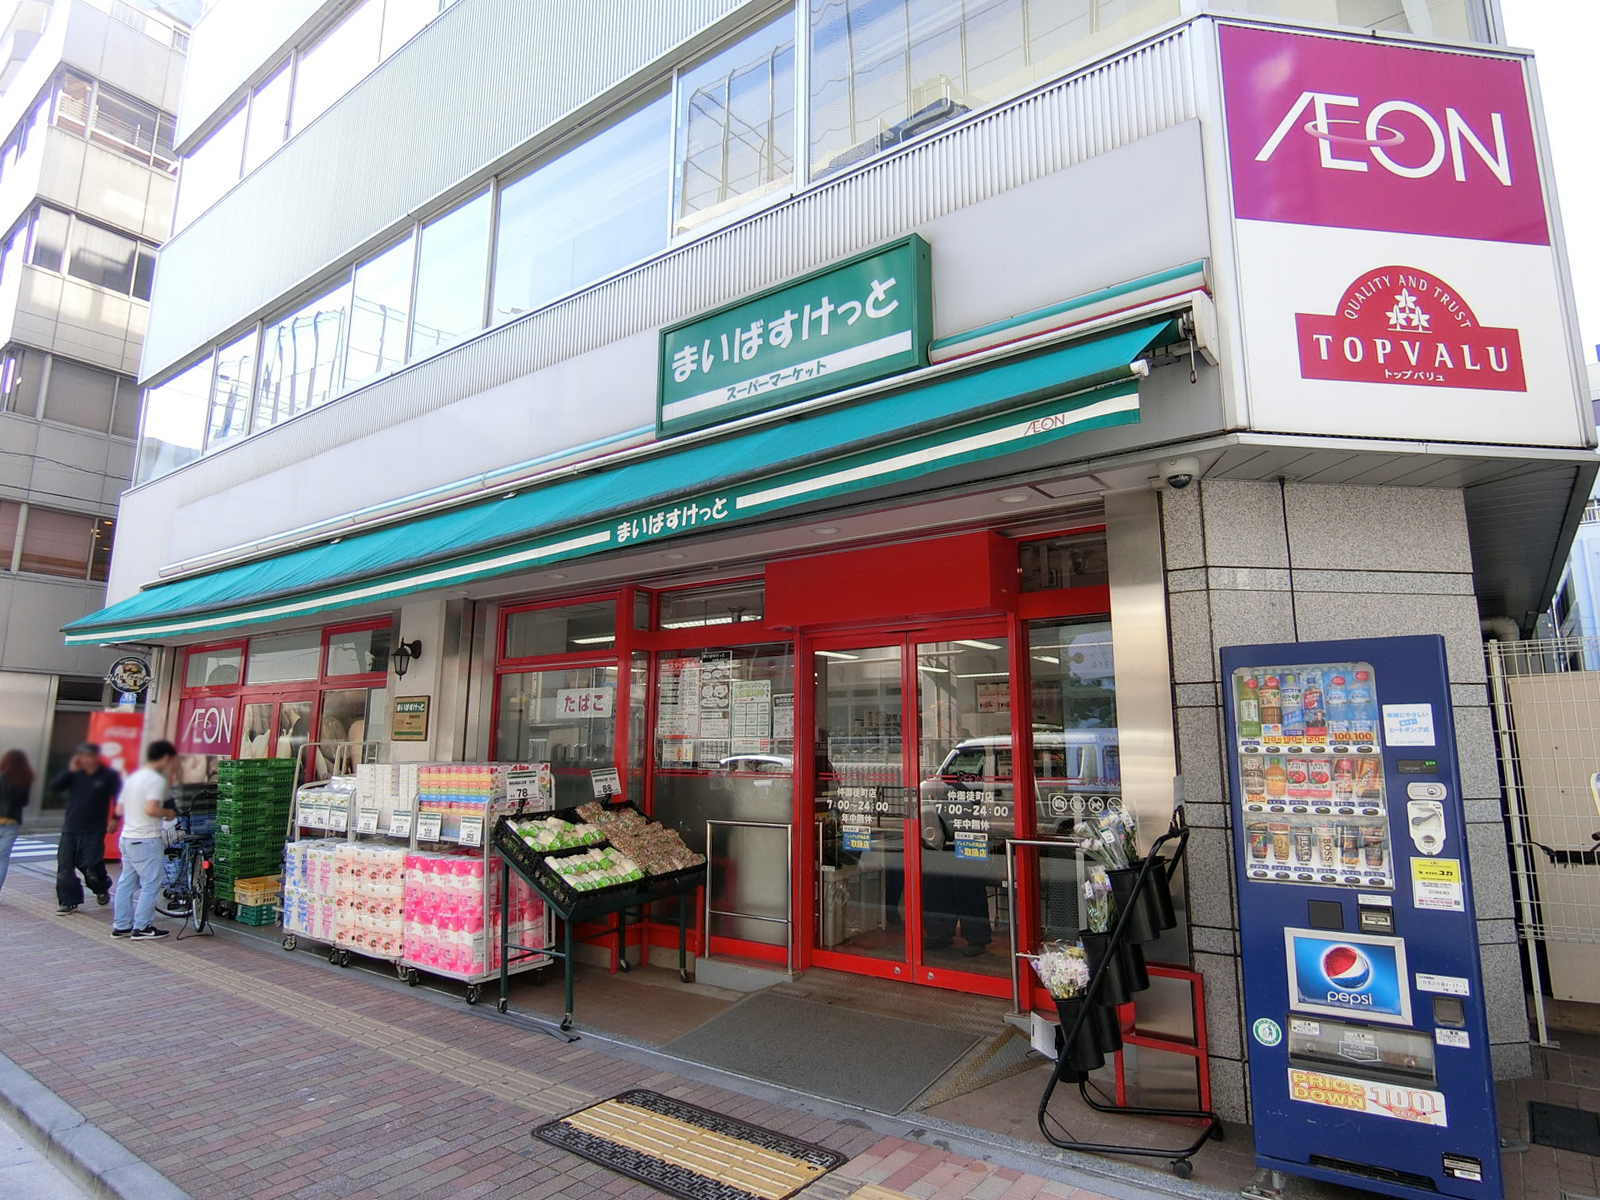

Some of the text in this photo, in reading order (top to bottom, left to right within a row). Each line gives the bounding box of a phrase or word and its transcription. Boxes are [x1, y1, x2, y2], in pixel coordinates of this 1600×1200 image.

[1344, 274, 1471, 328] QUALITY AND TRUST
[672, 277, 899, 383] まいばすけっと
[1312, 334, 1508, 372] TOPVALU
[727, 360, 826, 401] スーパーマーケット
[1385, 369, 1445, 382] トップバリュ
[617, 498, 728, 542] まいばすけっと
[564, 694, 603, 712] たばこ
[517, 788, 528, 797] 78
[837, 787, 877, 798] 仲御徒町店
[947, 790, 994, 801] 仲御徒町店
[842, 813, 872, 824] 年中無休
[953, 819, 990, 830] 年中無休
[1323, 838, 1333, 862] BOSS
[1327, 991, 1372, 1005] pepsi
[1292, 1072, 1365, 1095] PRICE
[1293, 1085, 1366, 1111] DOWN
